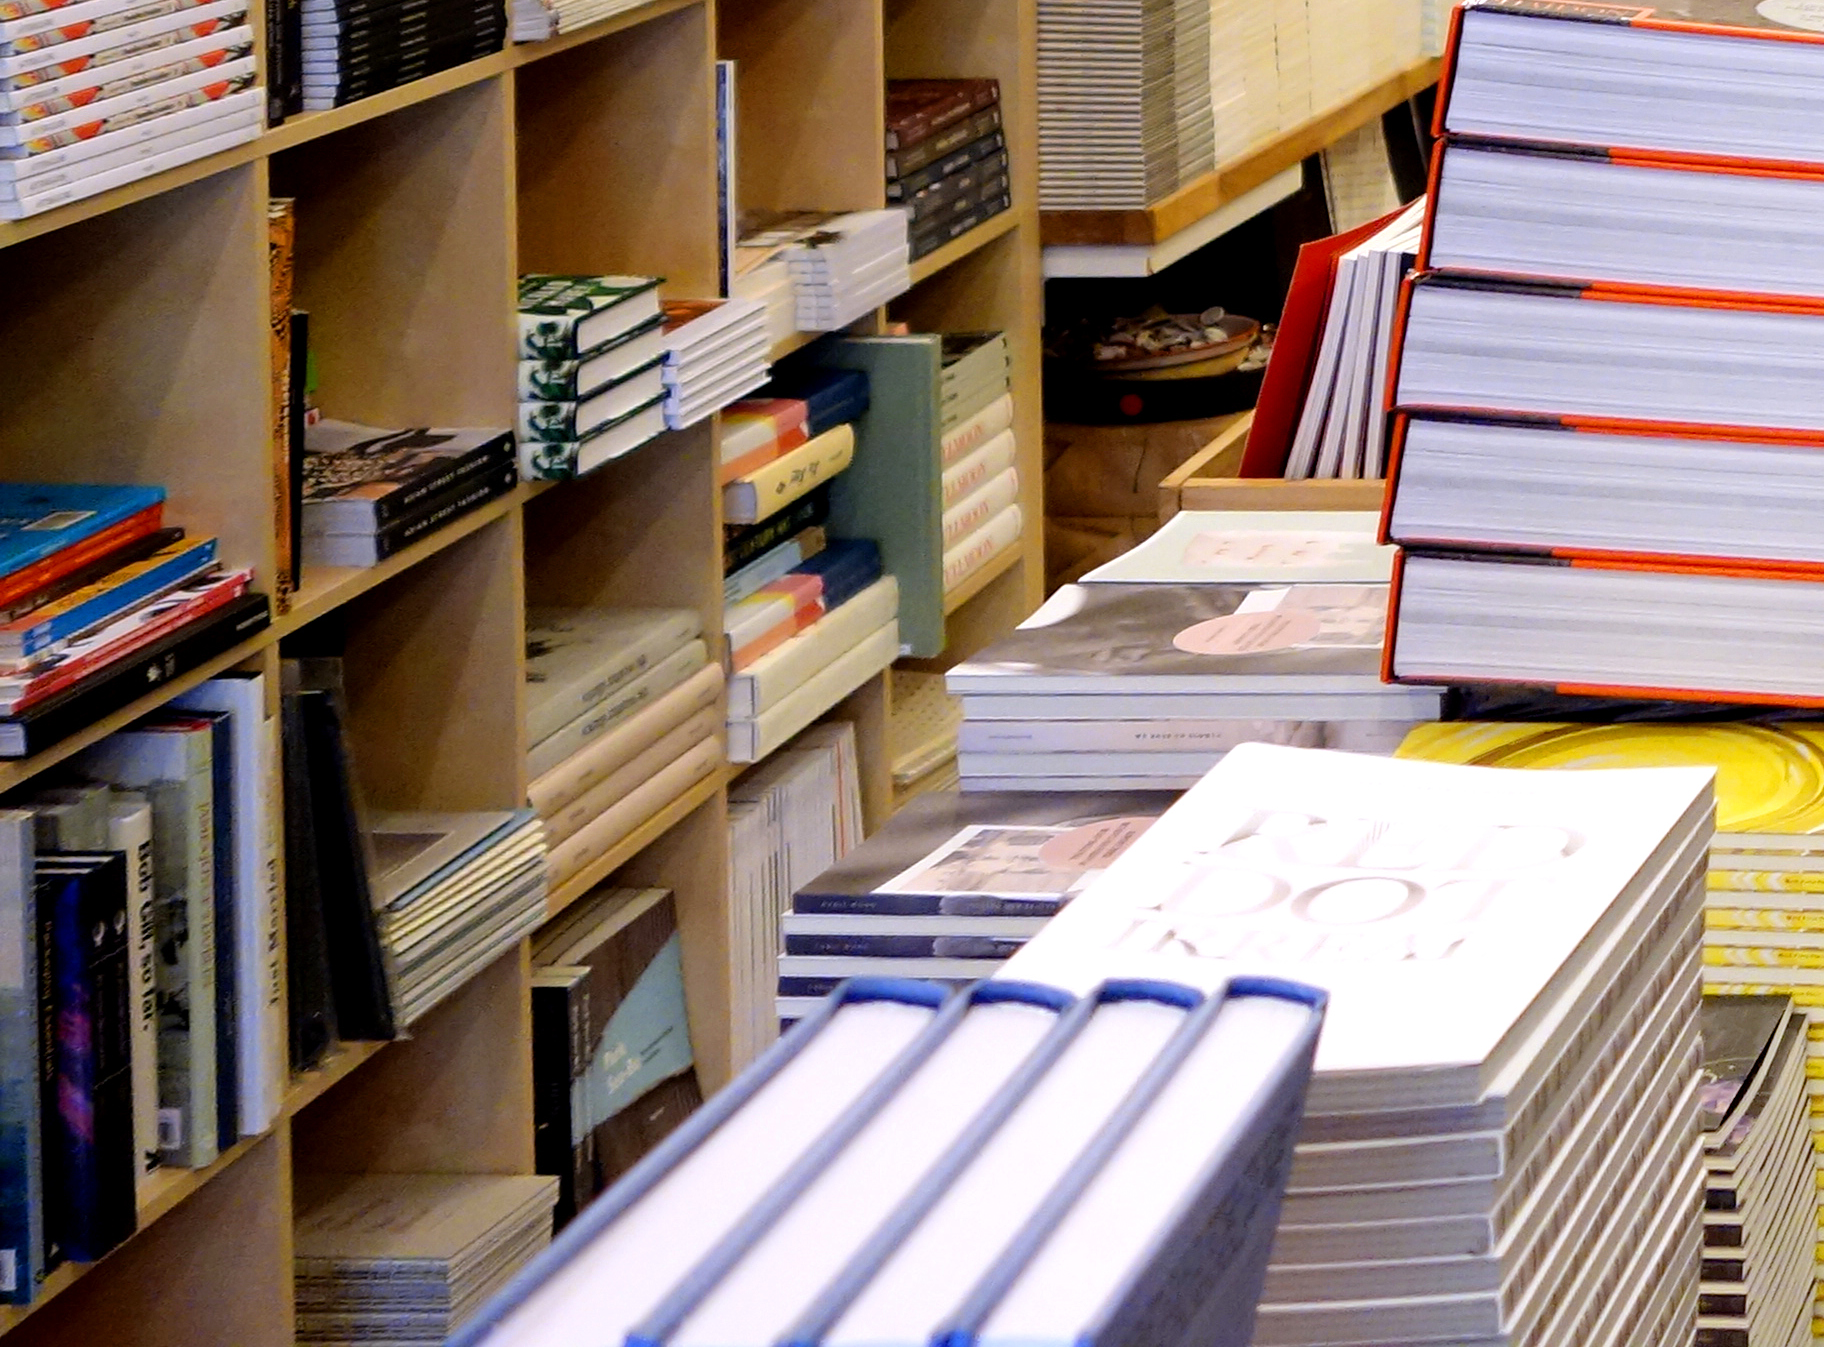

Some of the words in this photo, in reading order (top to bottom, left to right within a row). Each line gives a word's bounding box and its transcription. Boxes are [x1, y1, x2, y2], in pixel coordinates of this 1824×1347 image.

[138, 840, 154, 892] Bob
[1137, 875, 1557, 925] DOT
[138, 899, 155, 953] Gill,
[140, 954, 155, 982] so
[141, 988, 156, 1033] far.
